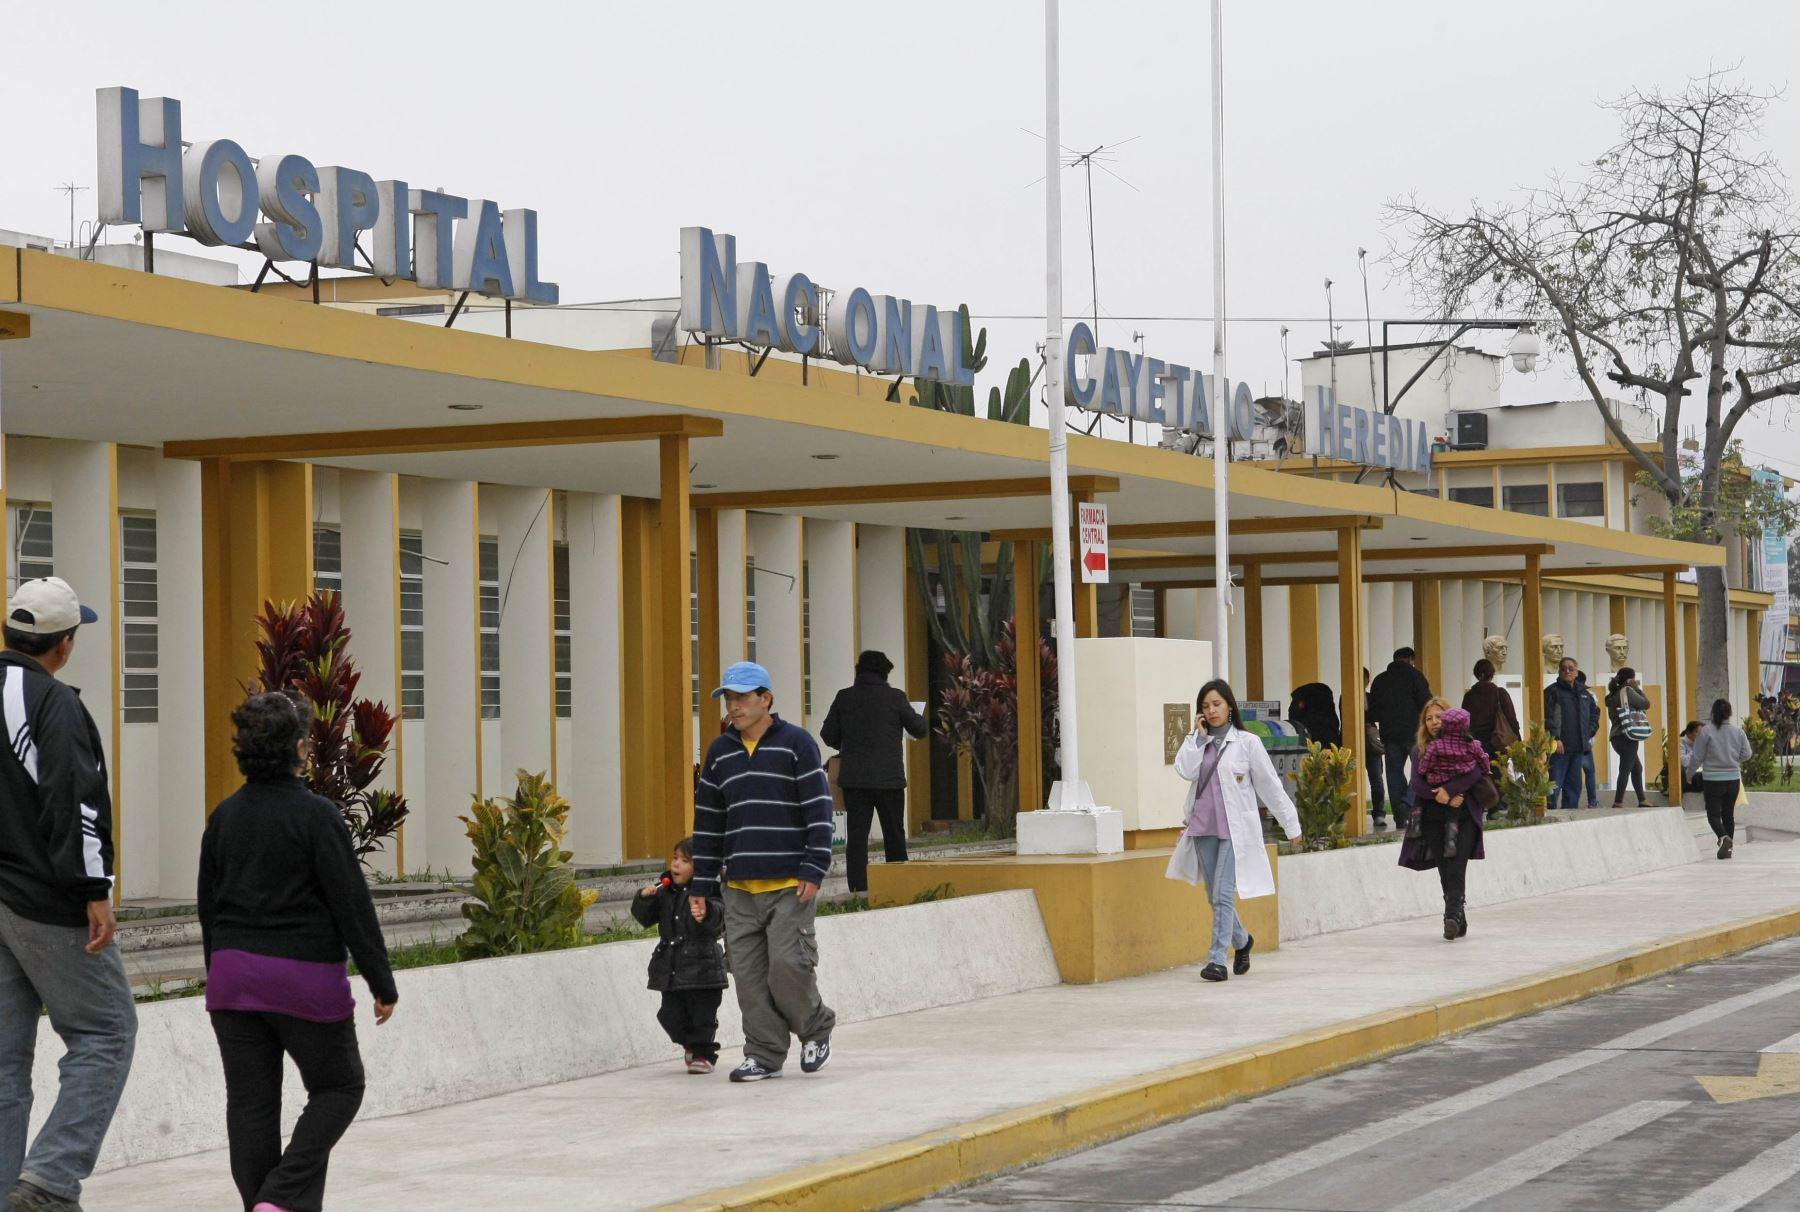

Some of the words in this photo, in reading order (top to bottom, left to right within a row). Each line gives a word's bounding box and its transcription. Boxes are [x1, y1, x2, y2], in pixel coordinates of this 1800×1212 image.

[96, 86, 559, 305] HOSPITAL
[680, 226, 974, 386] NACONAL
[1304, 384, 1432, 474] HEREDIA
[1081, 508, 1105, 526] FARMACIA
[1082, 527, 1104, 545] CENTRAL
